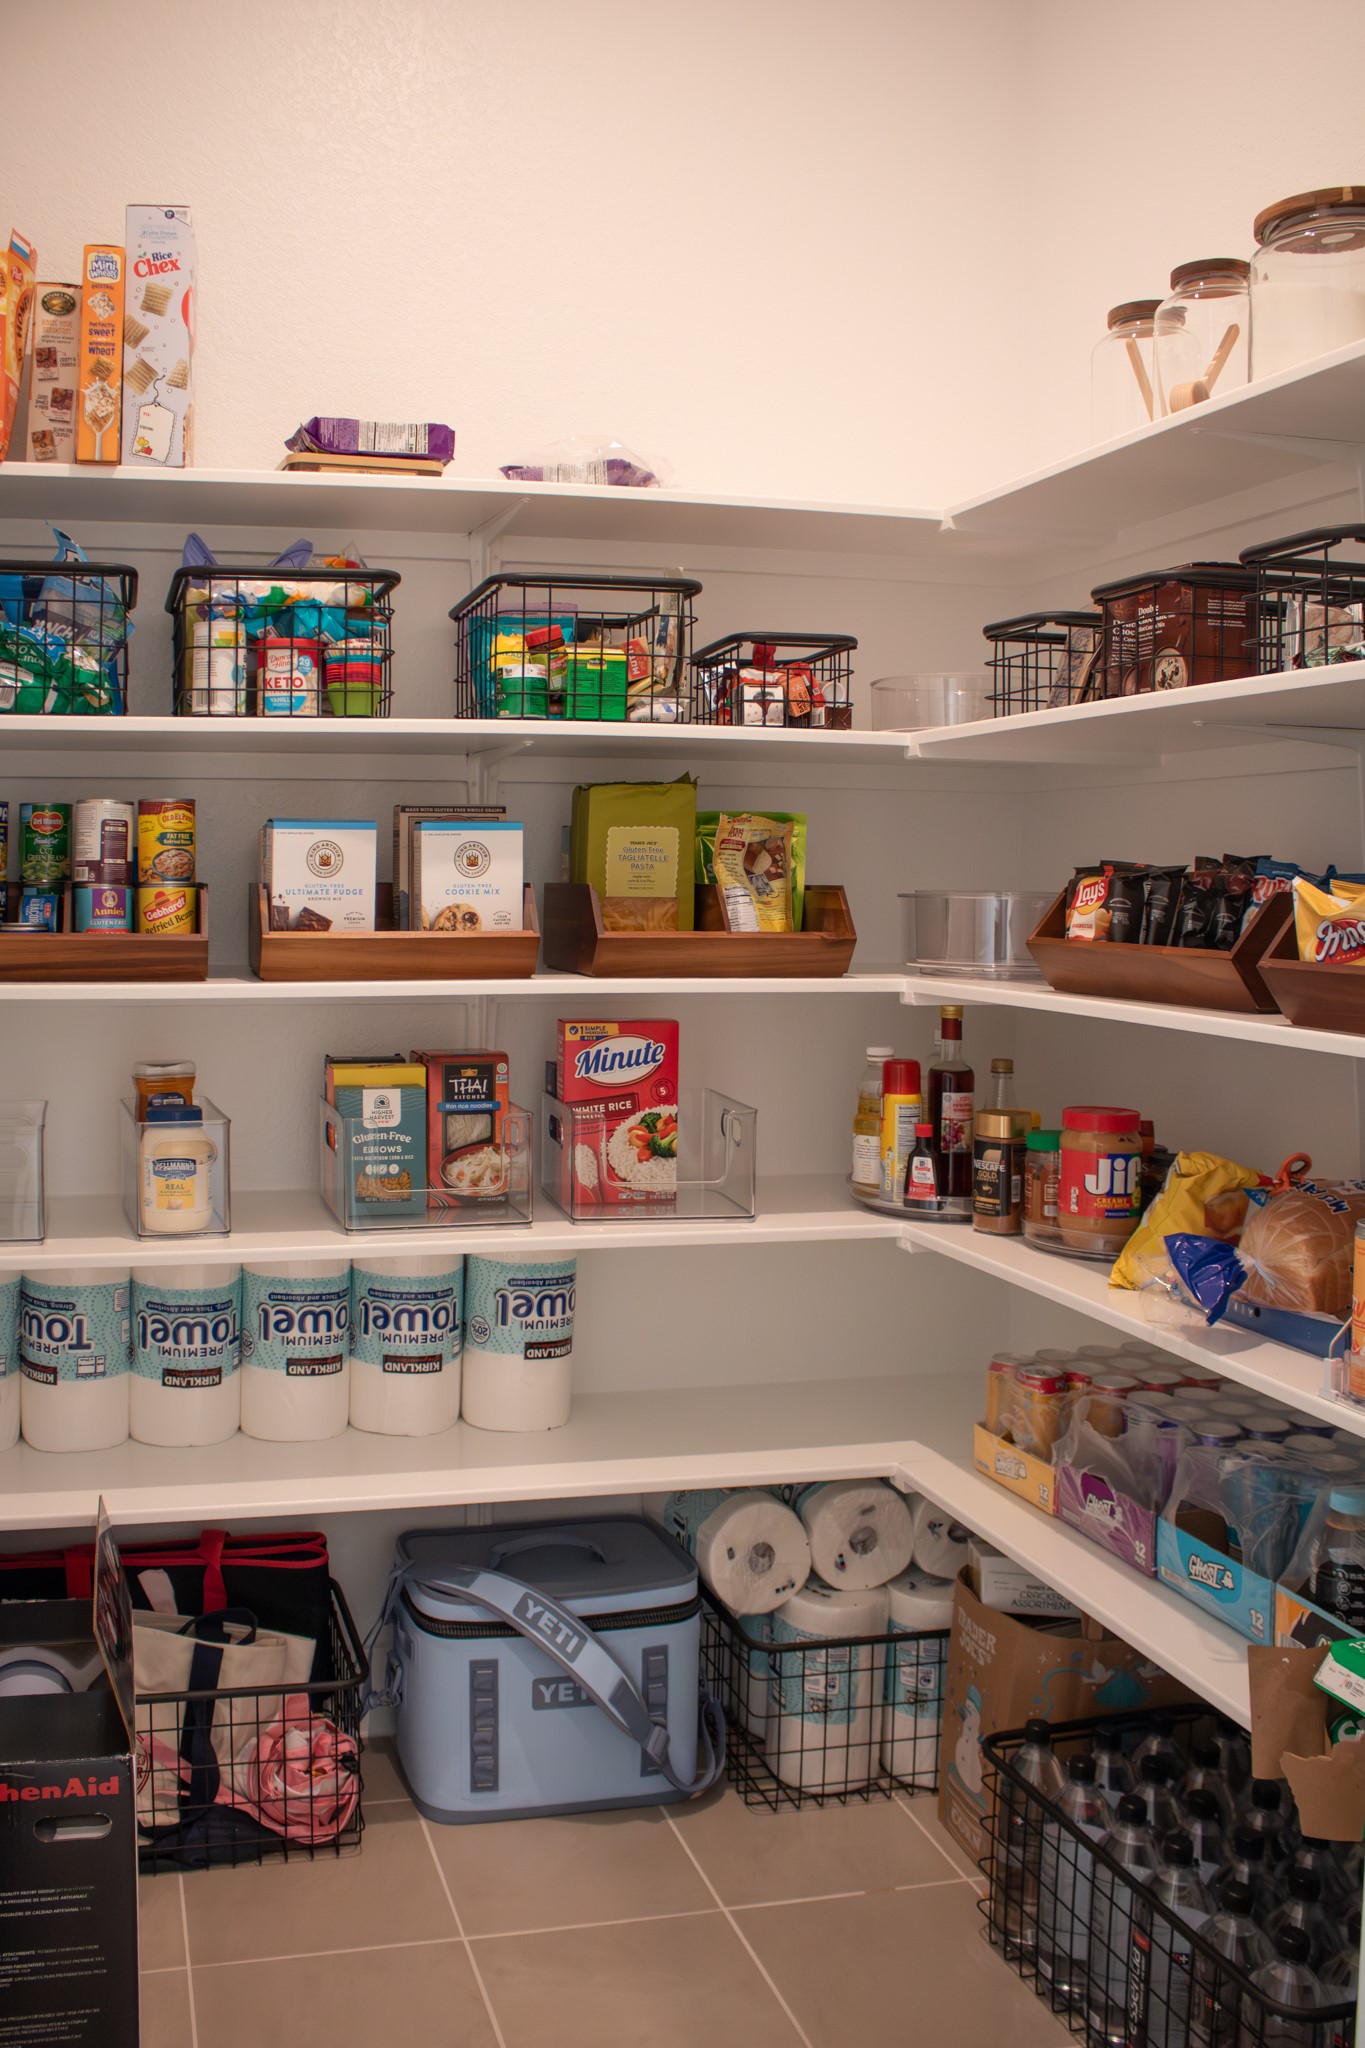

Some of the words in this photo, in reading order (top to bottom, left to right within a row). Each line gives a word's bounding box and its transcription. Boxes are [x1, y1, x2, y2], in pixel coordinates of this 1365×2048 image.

[151, 252, 173, 262] Rice
[92, 260, 116, 270] Mini
[134, 258, 181, 278] Chex
[90, 268, 119, 280] Wheats
[88, 328, 116, 336] sweet
[1138, 604, 1159, 616] Doube
[265, 677, 304, 688] KETO
[162, 813, 174, 823] OLD
[309, 844, 320, 858] KING
[320, 842, 341, 858] ARTHUR
[457, 845, 468, 858] KING
[468, 843, 488, 858] ARTHUR
[618, 854, 670, 862] TAGLIATELLE
[286, 888, 330, 896] ULTIMATE
[333, 888, 363, 896] FUDGE
[445, 888, 480, 896] COOKIE
[484, 888, 500, 896] MIX
[1075, 880, 1105, 908] Lay's
[94, 907, 125, 916] Annie's
[146, 896, 186, 920] Gebhardt
[145, 918, 174, 934] Refried
[175, 908, 194, 924] Beans
[580, 1026, 584, 1034] 1
[576, 1041, 664, 1077] Minute
[448, 1078, 487, 1094] THAI
[660, 1087, 666, 1095] 5
[572, 1104, 606, 1112] WHITE
[608, 1100, 632, 1111] RICE
[978, 1170, 997, 1178] GOLD
[1084, 1156, 1142, 1195] Jif
[370, 1290, 400, 1299] Absorbent
[148, 1302, 178, 1313] Absorbent
[262, 1304, 347, 1341] owel
[361, 1300, 460, 1336] Towel
[139, 1312, 240, 1350] Towel
[471, 1322, 488, 1336] 20%
[286, 1334, 344, 1346] PREMIUM
[382, 1333, 444, 1344] PREMIUM
[162, 1345, 224, 1358] PREMIUM
[526, 1345, 571, 1358] KIRKLAND
[289, 1361, 341, 1375] KIRKLAND
[384, 1361, 440, 1373] KIRKLAND
[164, 1374, 219, 1386] KIRKLAND
[1039, 1484, 1049, 1500] 12
[1134, 1540, 1146, 1559] 12
[1188, 1553, 1224, 1589] GHOST
[1020, 1591, 1064, 1602] CRACKER
[1012, 1598, 1071, 1611] ASSORTMENT
[524, 1598, 580, 1654] YETI
[1250, 1609, 1264, 1630] 12
[958, 1606, 996, 1655] TRADER
[960, 1631, 986, 1666] JOE'S
